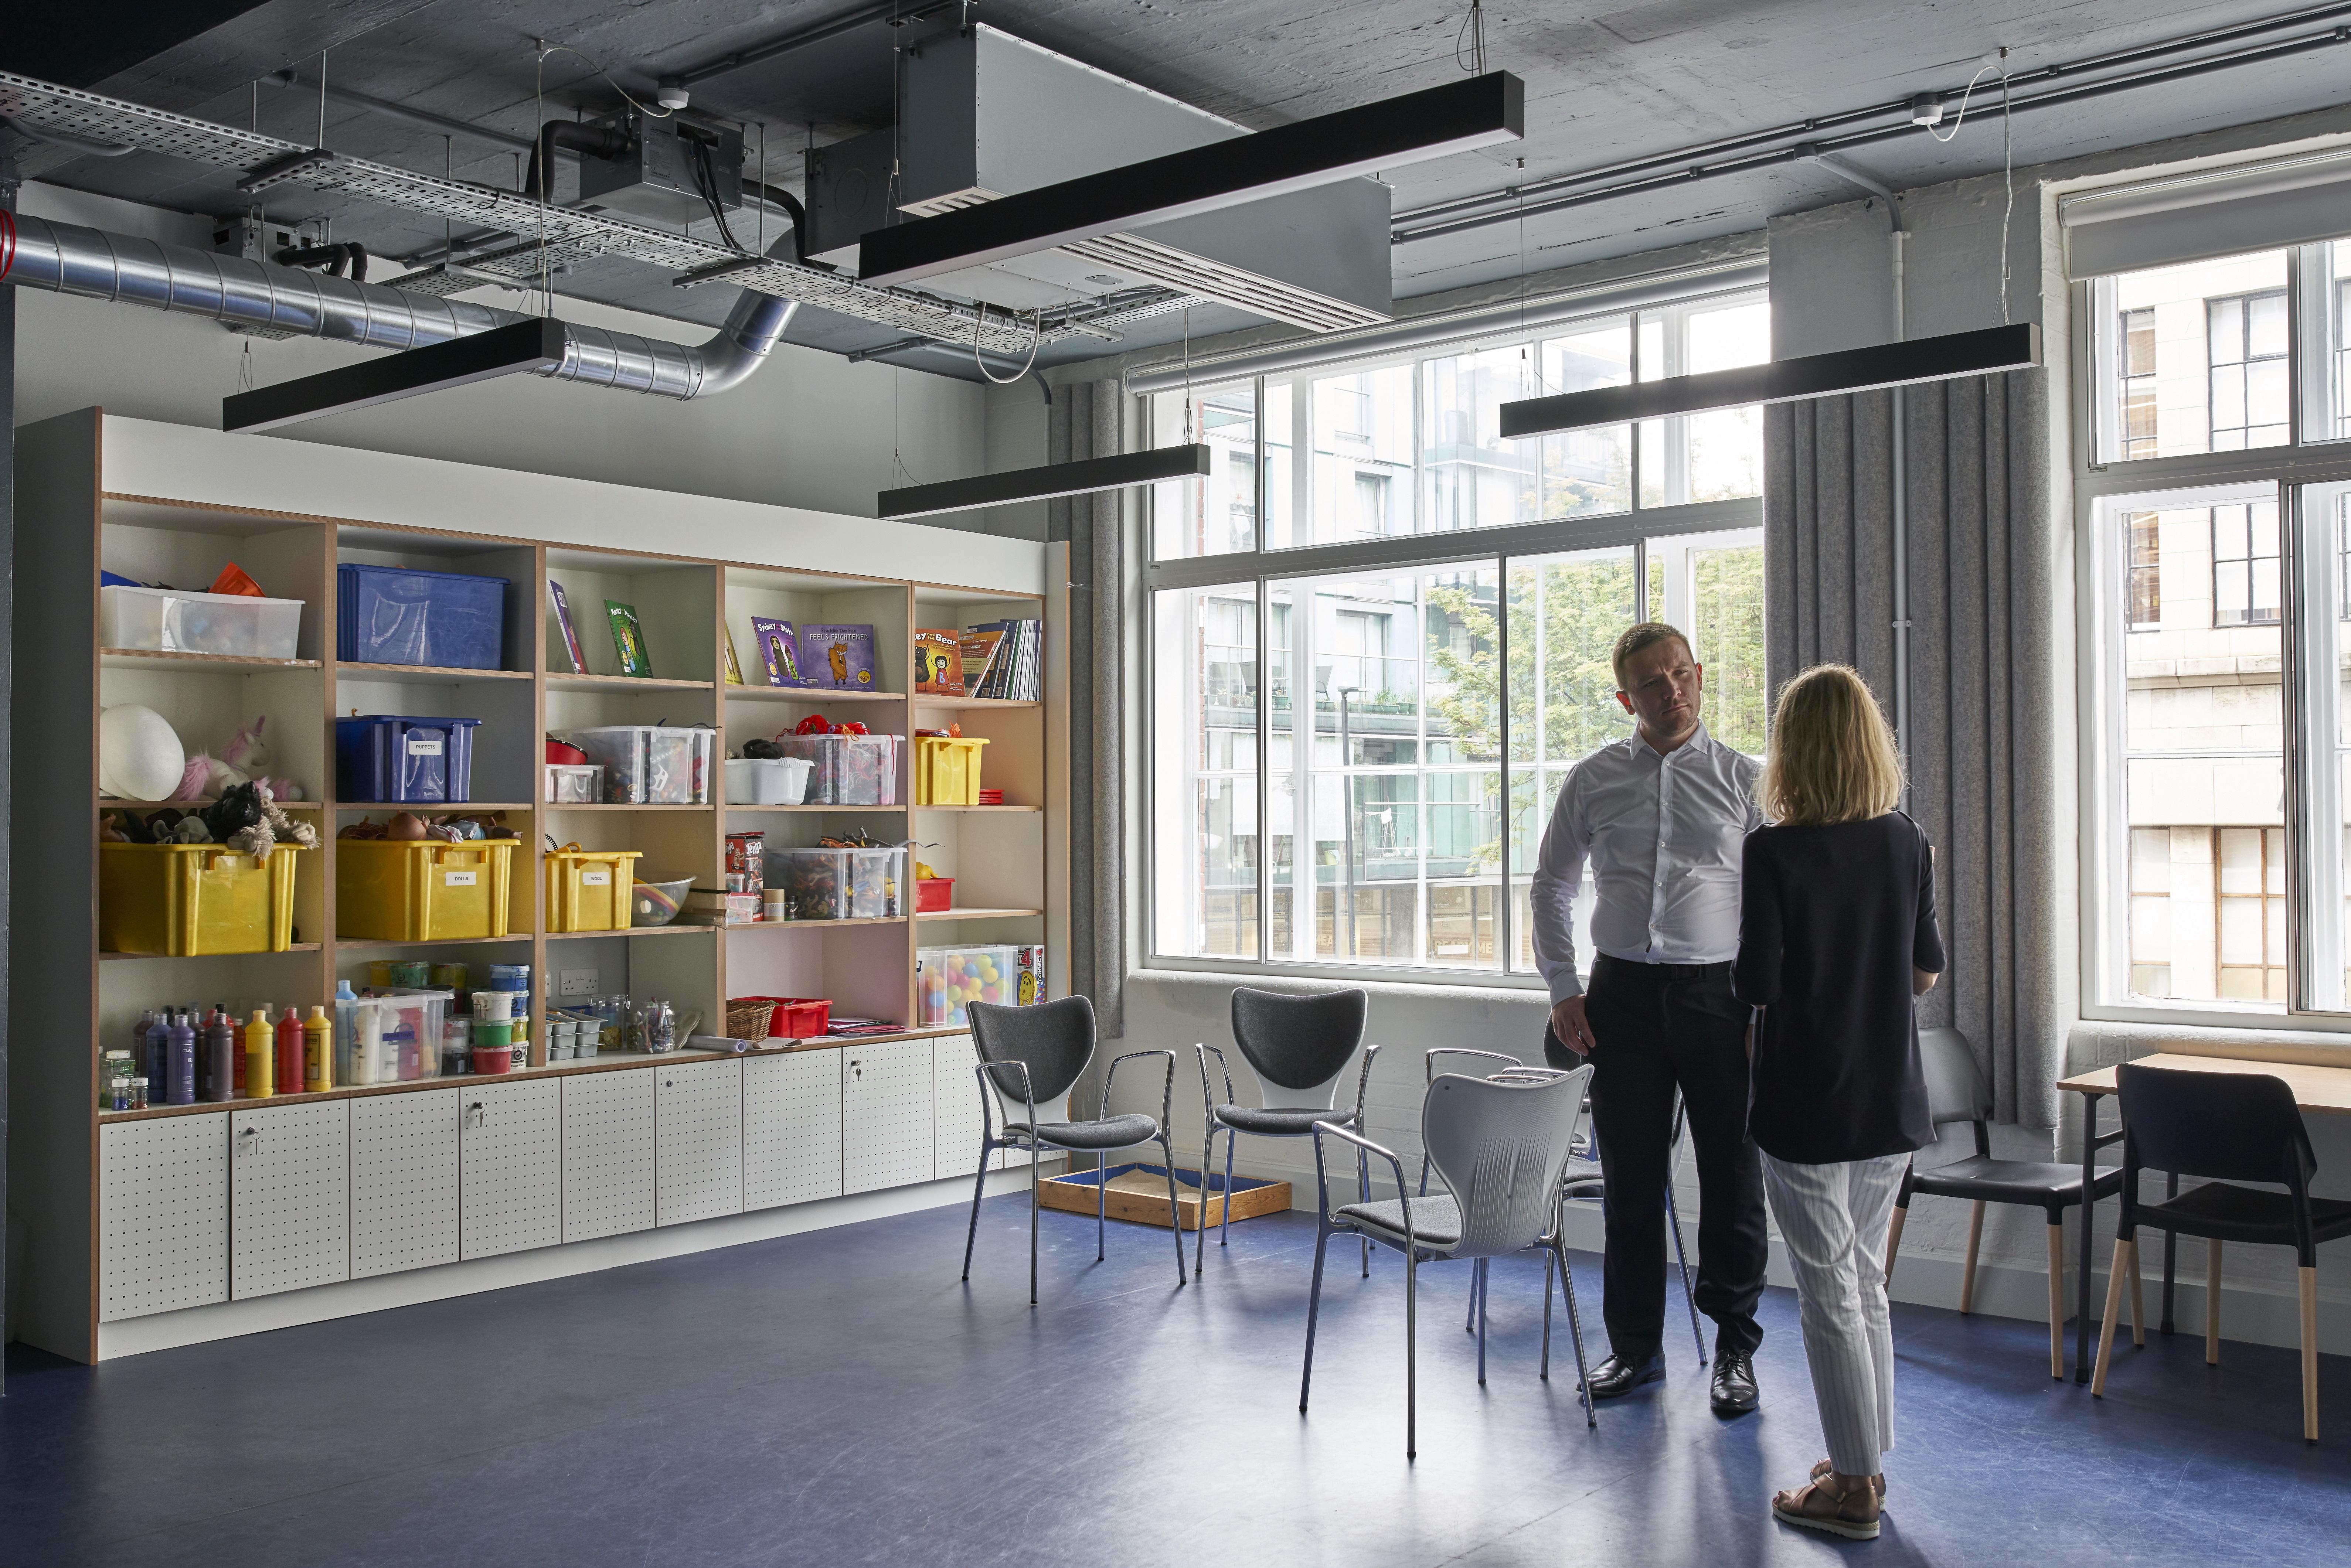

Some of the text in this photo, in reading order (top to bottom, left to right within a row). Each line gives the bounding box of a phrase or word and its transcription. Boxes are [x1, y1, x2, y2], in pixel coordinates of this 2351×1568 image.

[611, 607, 621, 616] Marley
[624, 609, 637, 624] Monkey
[758, 622, 776, 632] Sydney
[780, 624, 794, 637] Sloth
[936, 633, 957, 646] Bear
[791, 665, 796, 677] S
[939, 672, 945, 683] B
[746, 841, 762, 855] Jenga
[1021, 950, 1031, 967] 4
